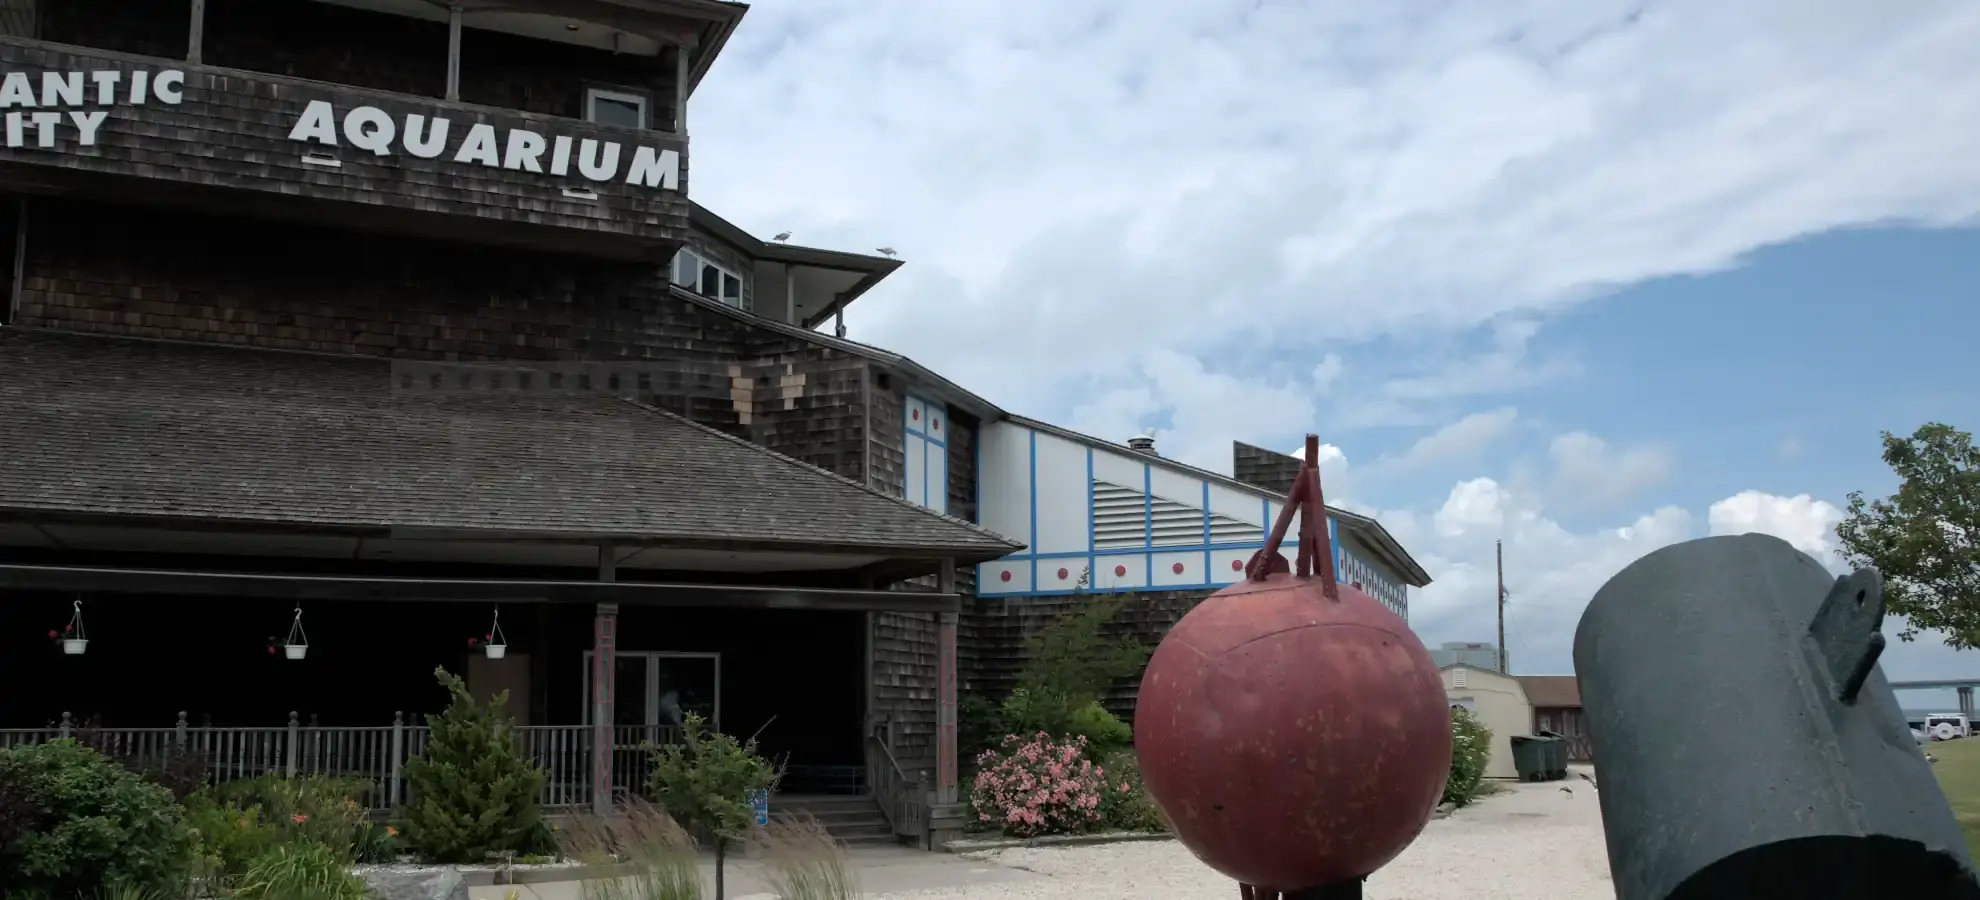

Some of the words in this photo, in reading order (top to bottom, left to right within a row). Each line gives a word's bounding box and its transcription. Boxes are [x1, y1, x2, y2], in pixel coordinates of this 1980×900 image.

[0, 70, 185, 107] ANTIC
[6, 111, 109, 147] ITY
[288, 100, 679, 190] AQUARIUM
